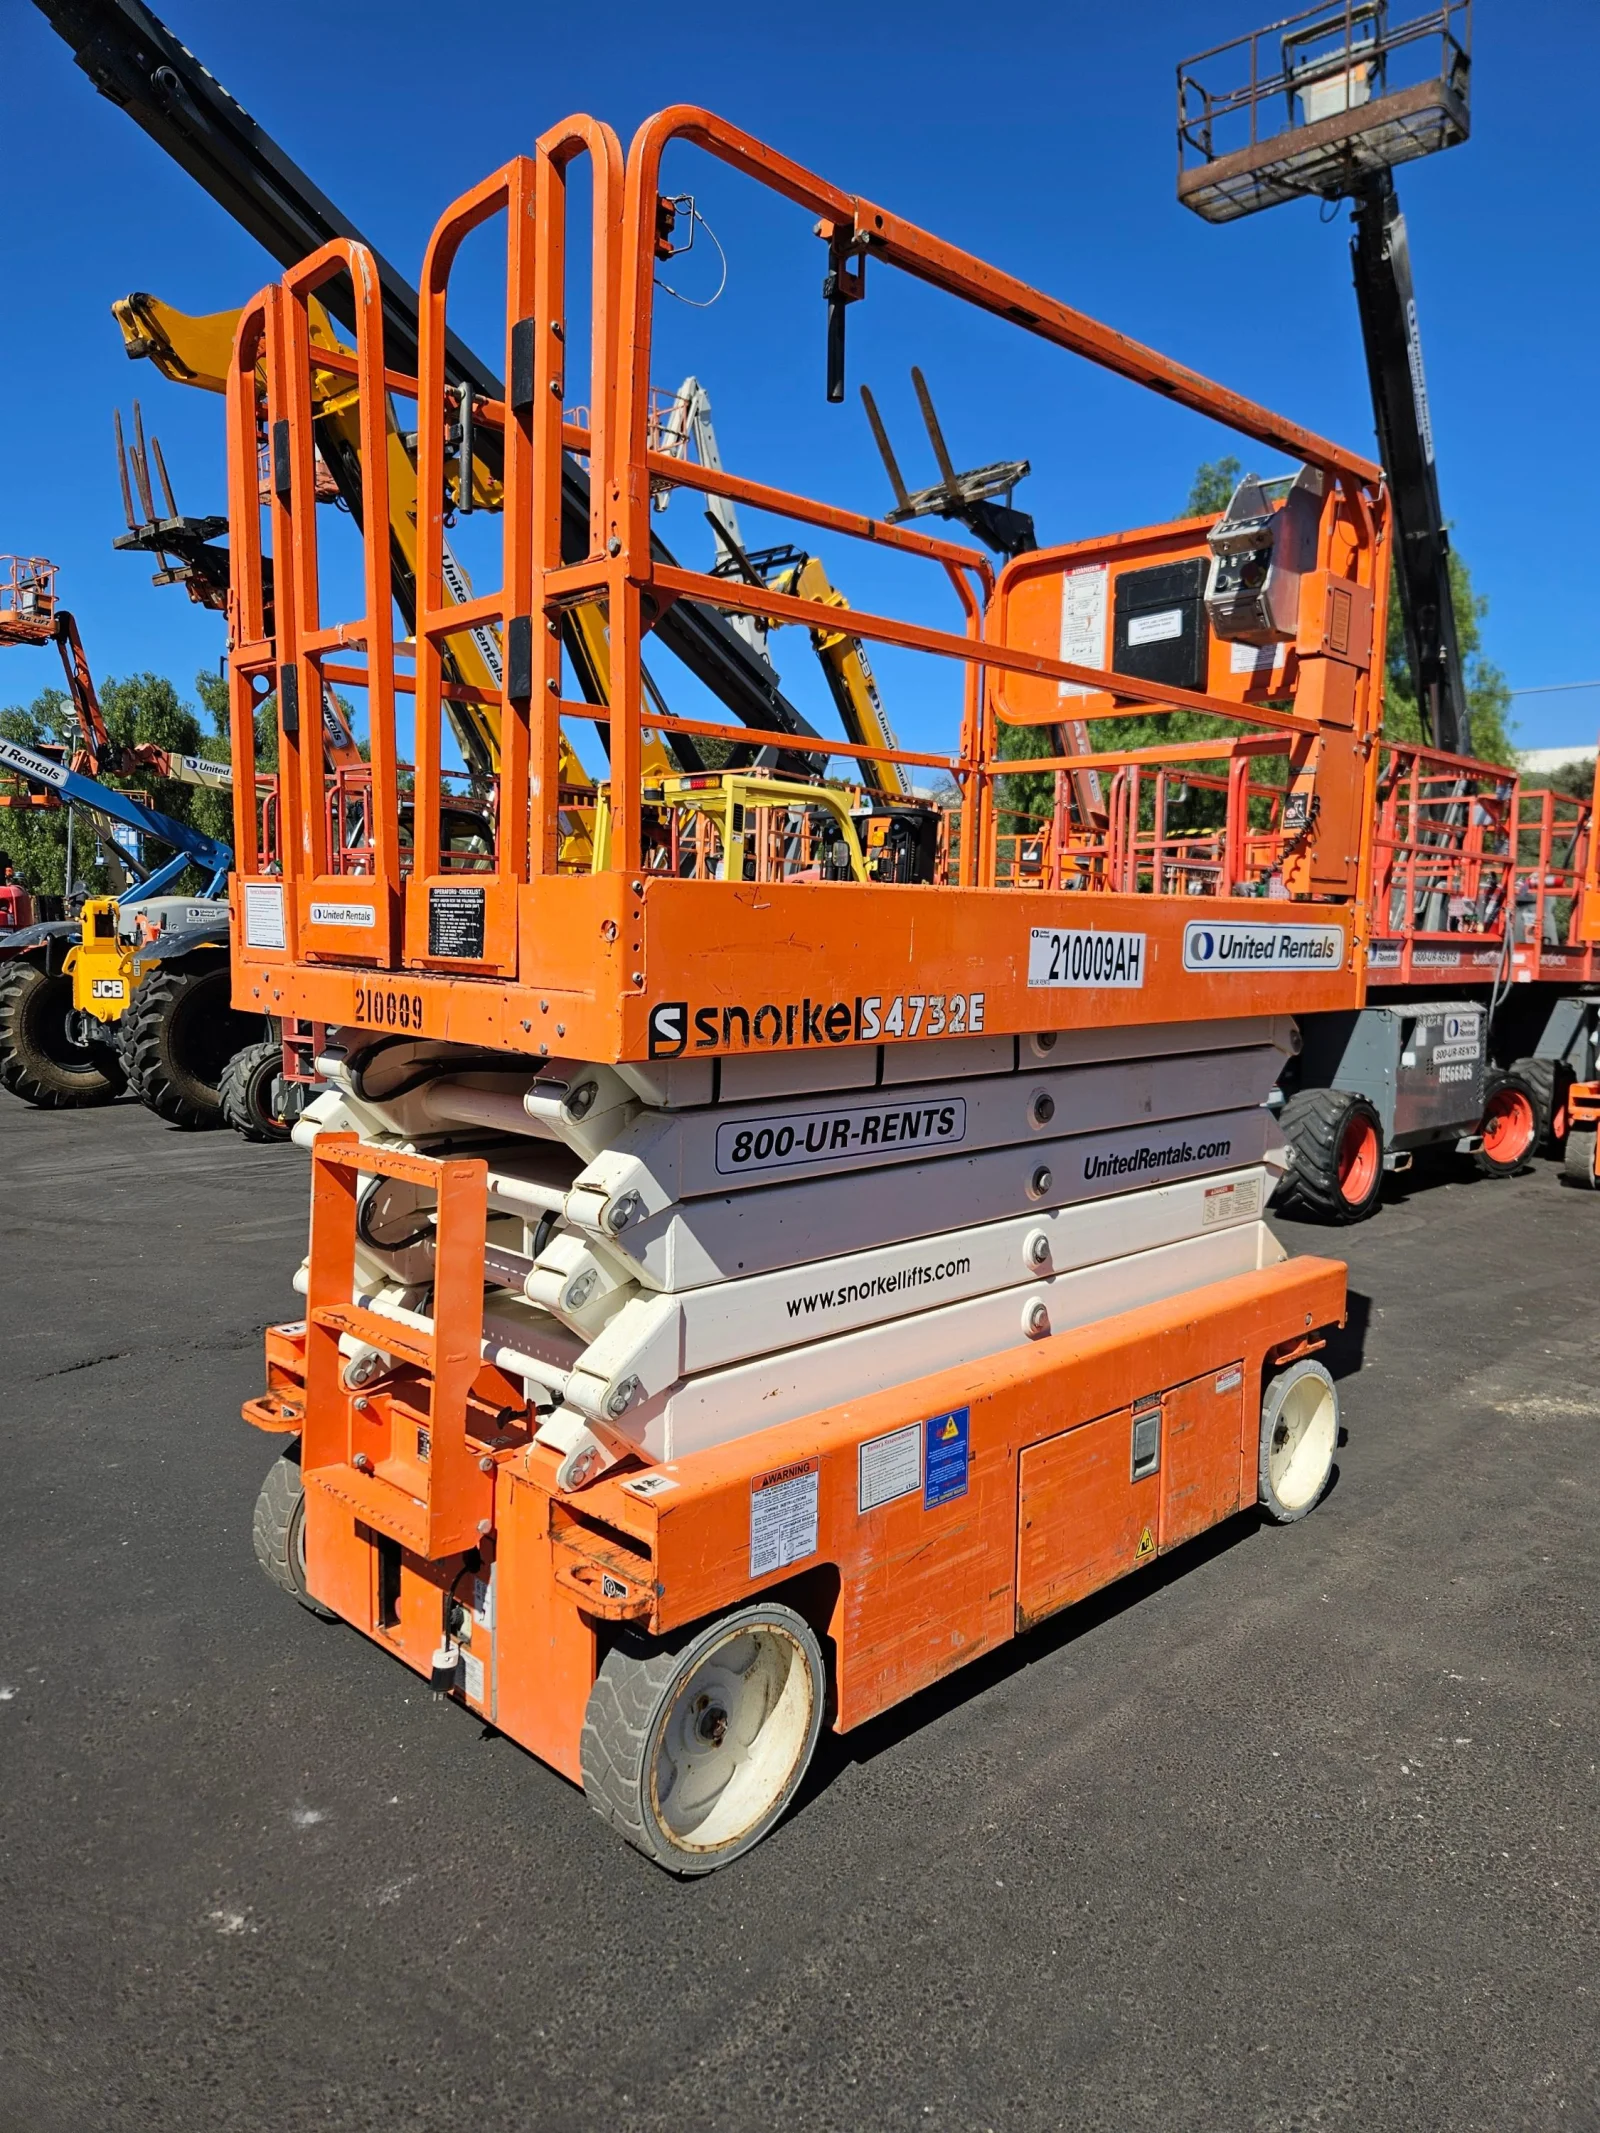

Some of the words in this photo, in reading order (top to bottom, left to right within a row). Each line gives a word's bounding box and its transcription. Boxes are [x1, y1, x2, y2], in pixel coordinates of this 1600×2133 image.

[442, 554, 467, 604] Unite
[852, 637, 872, 679] JCB
[877, 711, 895, 750] United
[8, 749, 60, 780] Rentals
[199, 762, 230, 776] United
[323, 909, 345, 920] United
[346, 910, 371, 921] Rentals
[1048, 934, 1141, 981] 210009AH
[1218, 934, 1277, 960] United
[1278, 935, 1335, 959] Rentals
[92, 980, 124, 998] JCB
[355, 988, 423, 1030] 210009
[694, 997, 863, 1049] snorkel
[861, 993, 985, 1040] S4732E
[731, 1106, 956, 1163] 800-UR-RENTS
[1083, 1140, 1231, 1180] UnitedRentals.com
[786, 1257, 970, 1318] www.snorkellifts.com
[767, 1462, 810, 1485] WARNING
